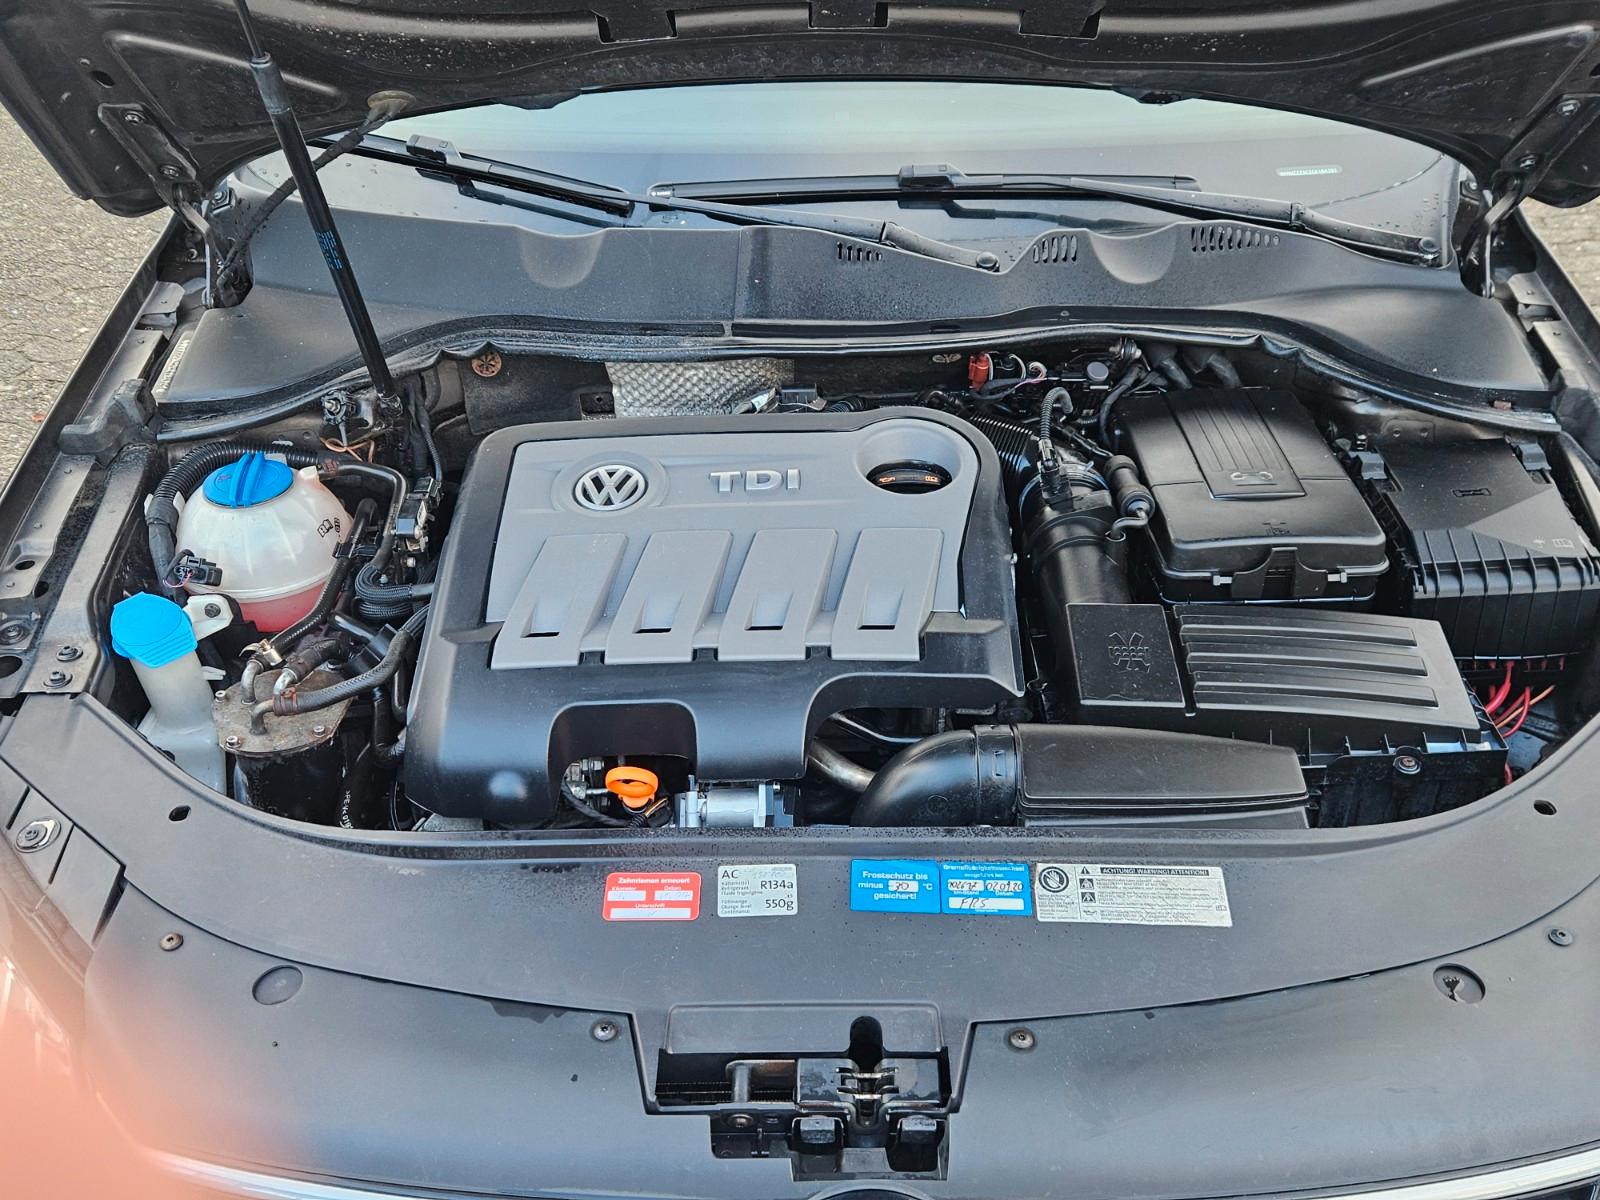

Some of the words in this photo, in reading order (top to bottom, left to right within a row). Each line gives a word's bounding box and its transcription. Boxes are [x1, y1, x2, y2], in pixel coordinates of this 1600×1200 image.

[709, 469, 800, 493] TDI
[575, 464, 646, 511] VW
[721, 869, 739, 879] AC
[862, 871, 914, 880] Frostschutz
[914, 872, 929, 880] bis
[760, 880, 794, 889] R134a
[922, 882, 933, 891] °C
[873, 892, 917, 900] gesichert!
[765, 899, 794, 911] 550g
